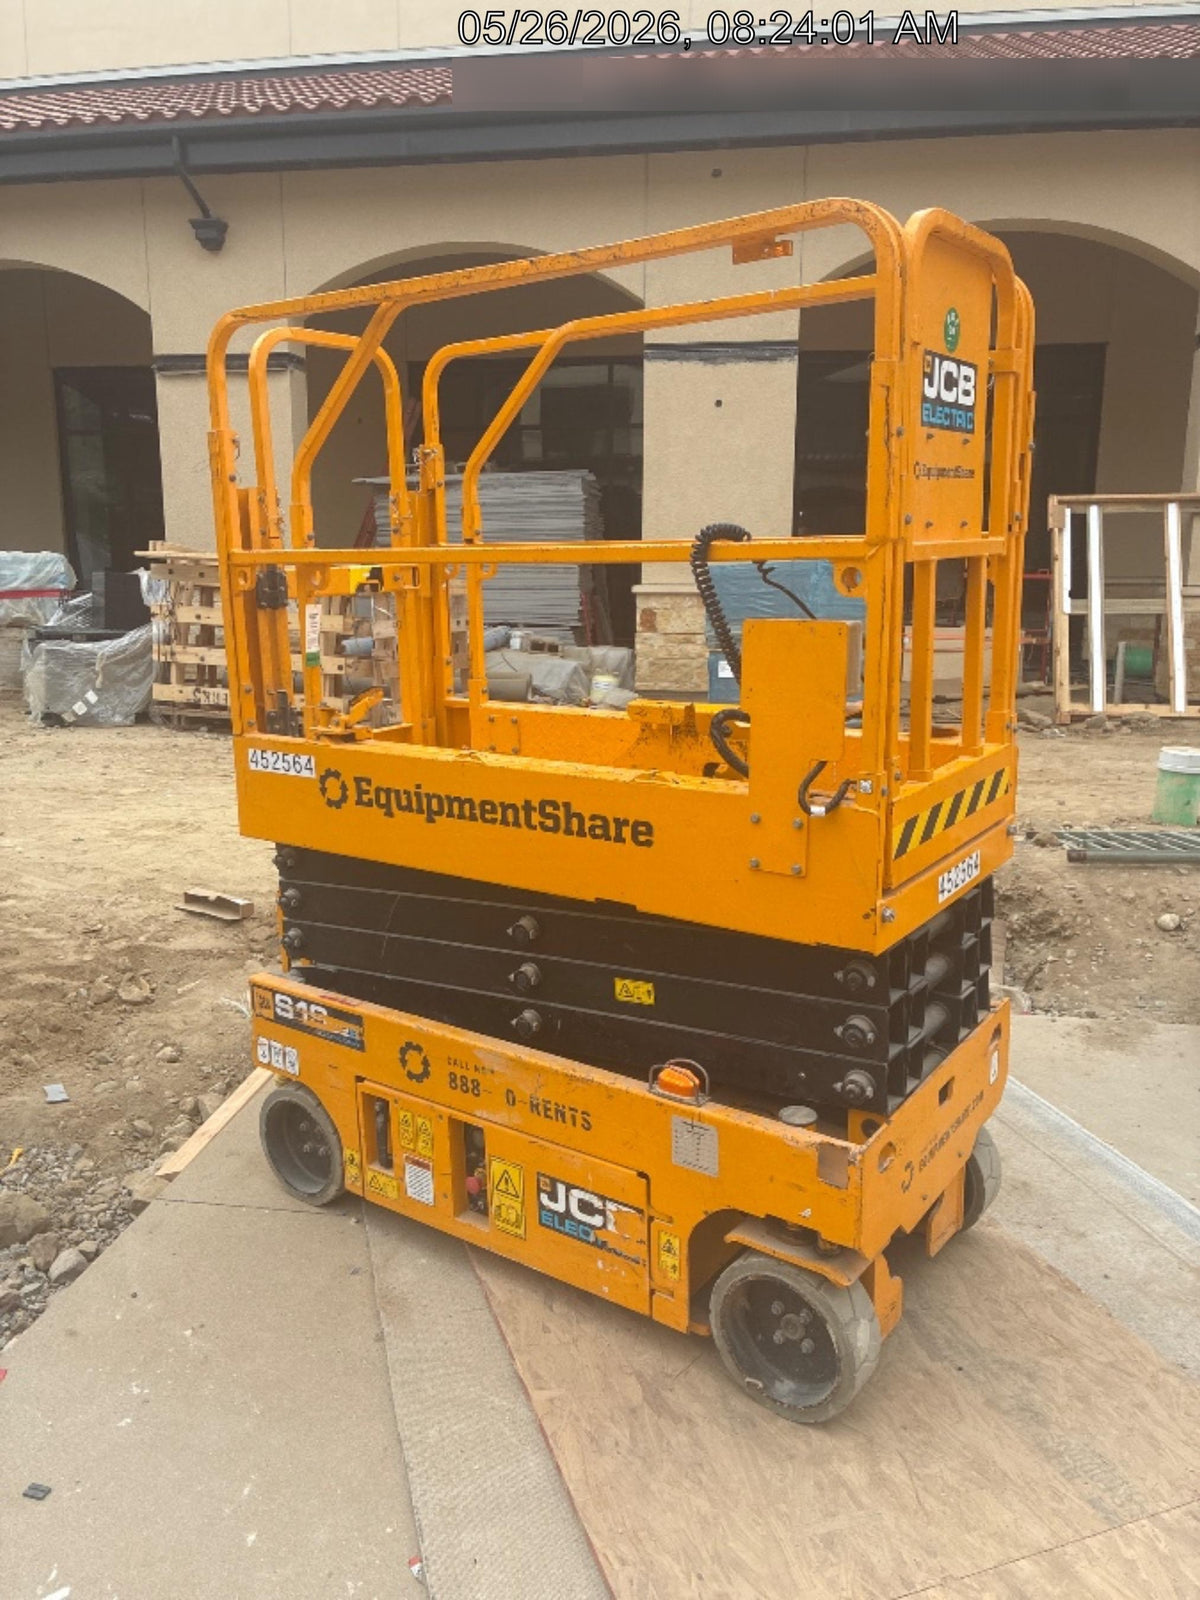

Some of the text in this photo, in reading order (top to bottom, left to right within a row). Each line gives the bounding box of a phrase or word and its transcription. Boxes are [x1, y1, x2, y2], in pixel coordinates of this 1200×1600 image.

[923, 356, 976, 407] JCB
[922, 403, 974, 430] ELECTRIC
[249, 749, 314, 775] 452564
[353, 775, 654, 849] EquipmentShare
